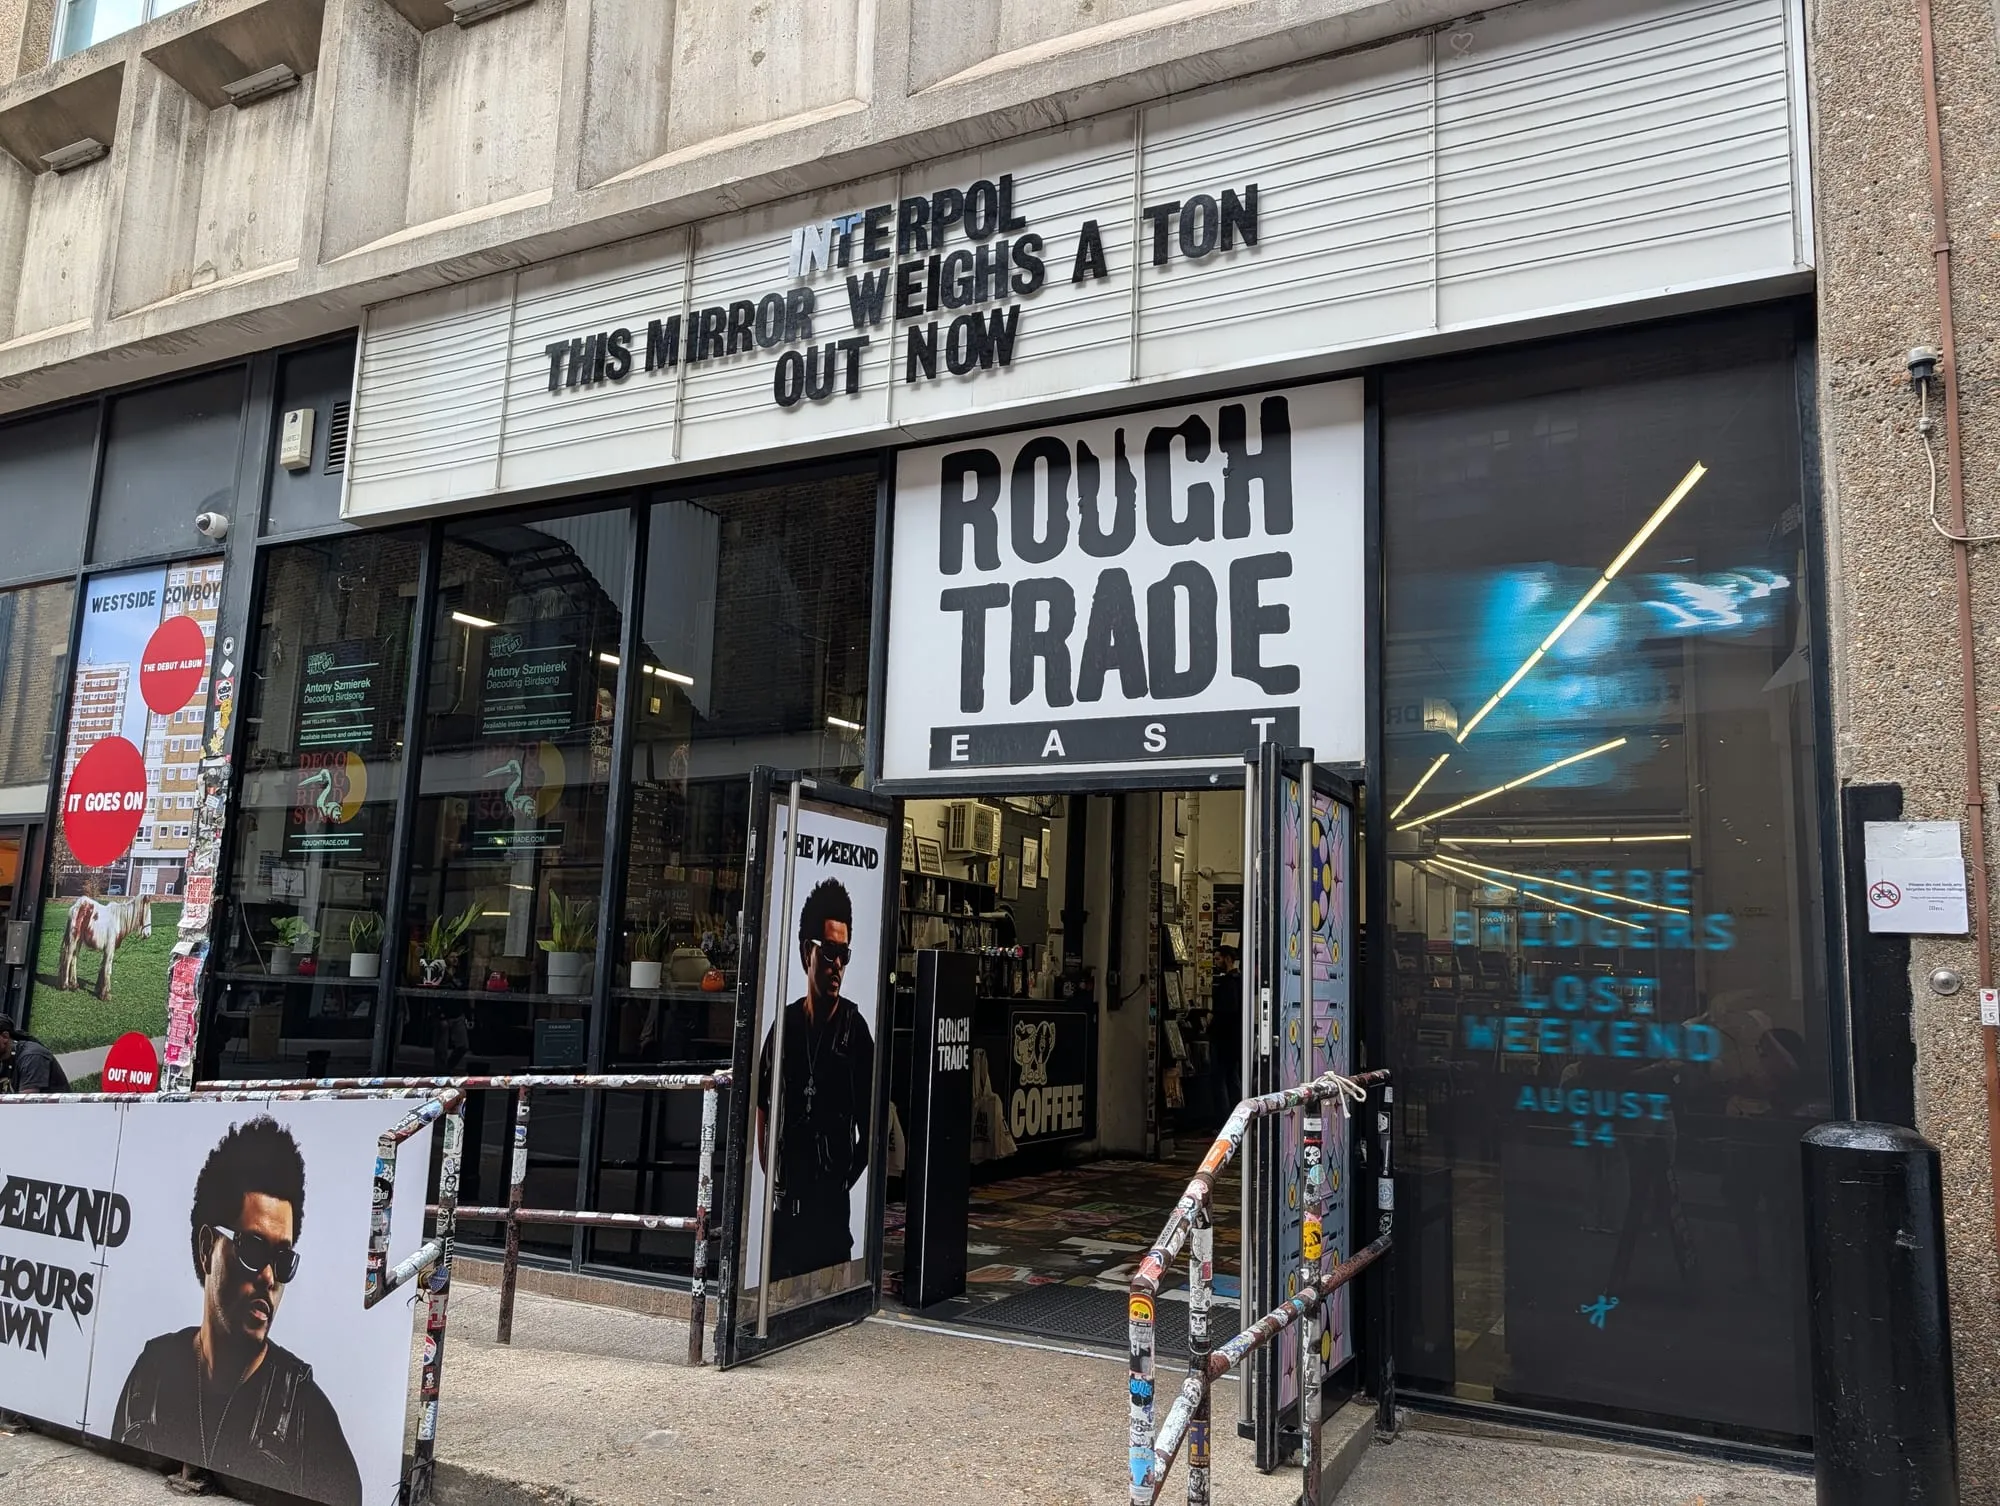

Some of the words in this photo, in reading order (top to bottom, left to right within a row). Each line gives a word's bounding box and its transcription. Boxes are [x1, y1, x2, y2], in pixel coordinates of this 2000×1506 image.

[787, 173, 1026, 280] INTERPOL
[545, 327, 631, 393] THIS
[645, 286, 813, 374] MIRROR
[847, 233, 1045, 330] WEIGHS
[1072, 219, 1107, 284] A
[1144, 184, 1259, 268] TON
[773, 335, 870, 408] OUT
[906, 304, 1020, 384] NOW
[938, 395, 1294, 575] ROUGH
[92, 590, 157, 614] WESTSIDE
[164, 582, 221, 604] COWBOY
[939, 551, 1301, 713] TRADE
[143, 663, 156, 673] THE
[157, 661, 179, 671] DEBUT
[179, 659, 203, 669] ALBUM
[487, 667, 521, 678] Antony
[522, 660, 568, 675] Szmierek
[303, 693, 335, 704] Decoding
[335, 692, 365, 701] Birdsong
[304, 683, 333, 694] Antony
[333, 677, 371, 691] Szmierek
[486, 679, 523, 690] Decoding
[524, 676, 560, 686] Birdsong
[300, 751, 347, 769] DECO
[67, 793, 82, 813] IT
[85, 792, 121, 813] GOES
[123, 790, 144, 811] ON
[816, 837, 879, 872] WEEKND
[1521, 974, 1661, 1015] LOST
[938, 1017, 970, 1043] ROUGH
[1464, 1015, 1722, 1062] WEEKEND
[938, 1045, 969, 1072] TRADE
[107, 1068, 129, 1085] OUT
[130, 1069, 153, 1085] NOW
[1011, 1084, 1084, 1138] COFFEE
[1516, 1085, 1671, 1121] AUGUST
[1570, 1121, 1616, 1149] 14
[0, 1174, 131, 1253] EEKND
